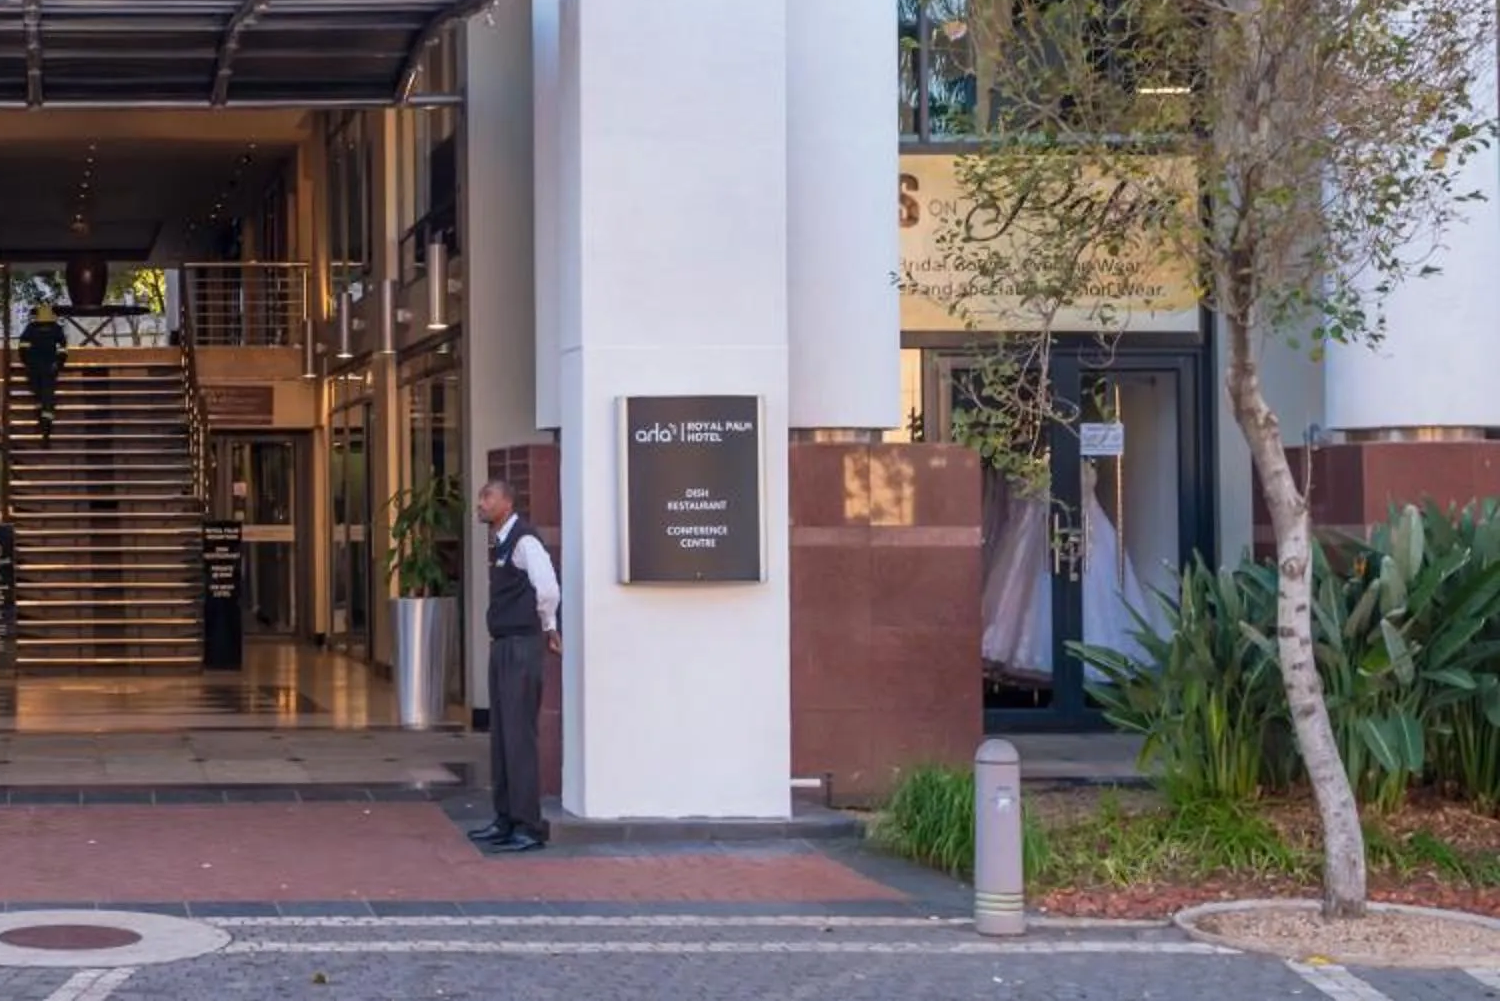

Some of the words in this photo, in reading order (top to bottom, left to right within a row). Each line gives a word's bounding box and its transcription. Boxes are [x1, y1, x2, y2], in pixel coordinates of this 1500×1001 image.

[928, 201, 957, 217] ON
[687, 421, 723, 431] ROYAL
[725, 420, 753, 431] PALM
[687, 432, 723, 442] HOTEL
[685, 487, 709, 498] DISH
[667, 500, 727, 511] RESTAURANT
[666, 525, 728, 536] CONFERENCE
[680, 538, 716, 548] CENTRE
